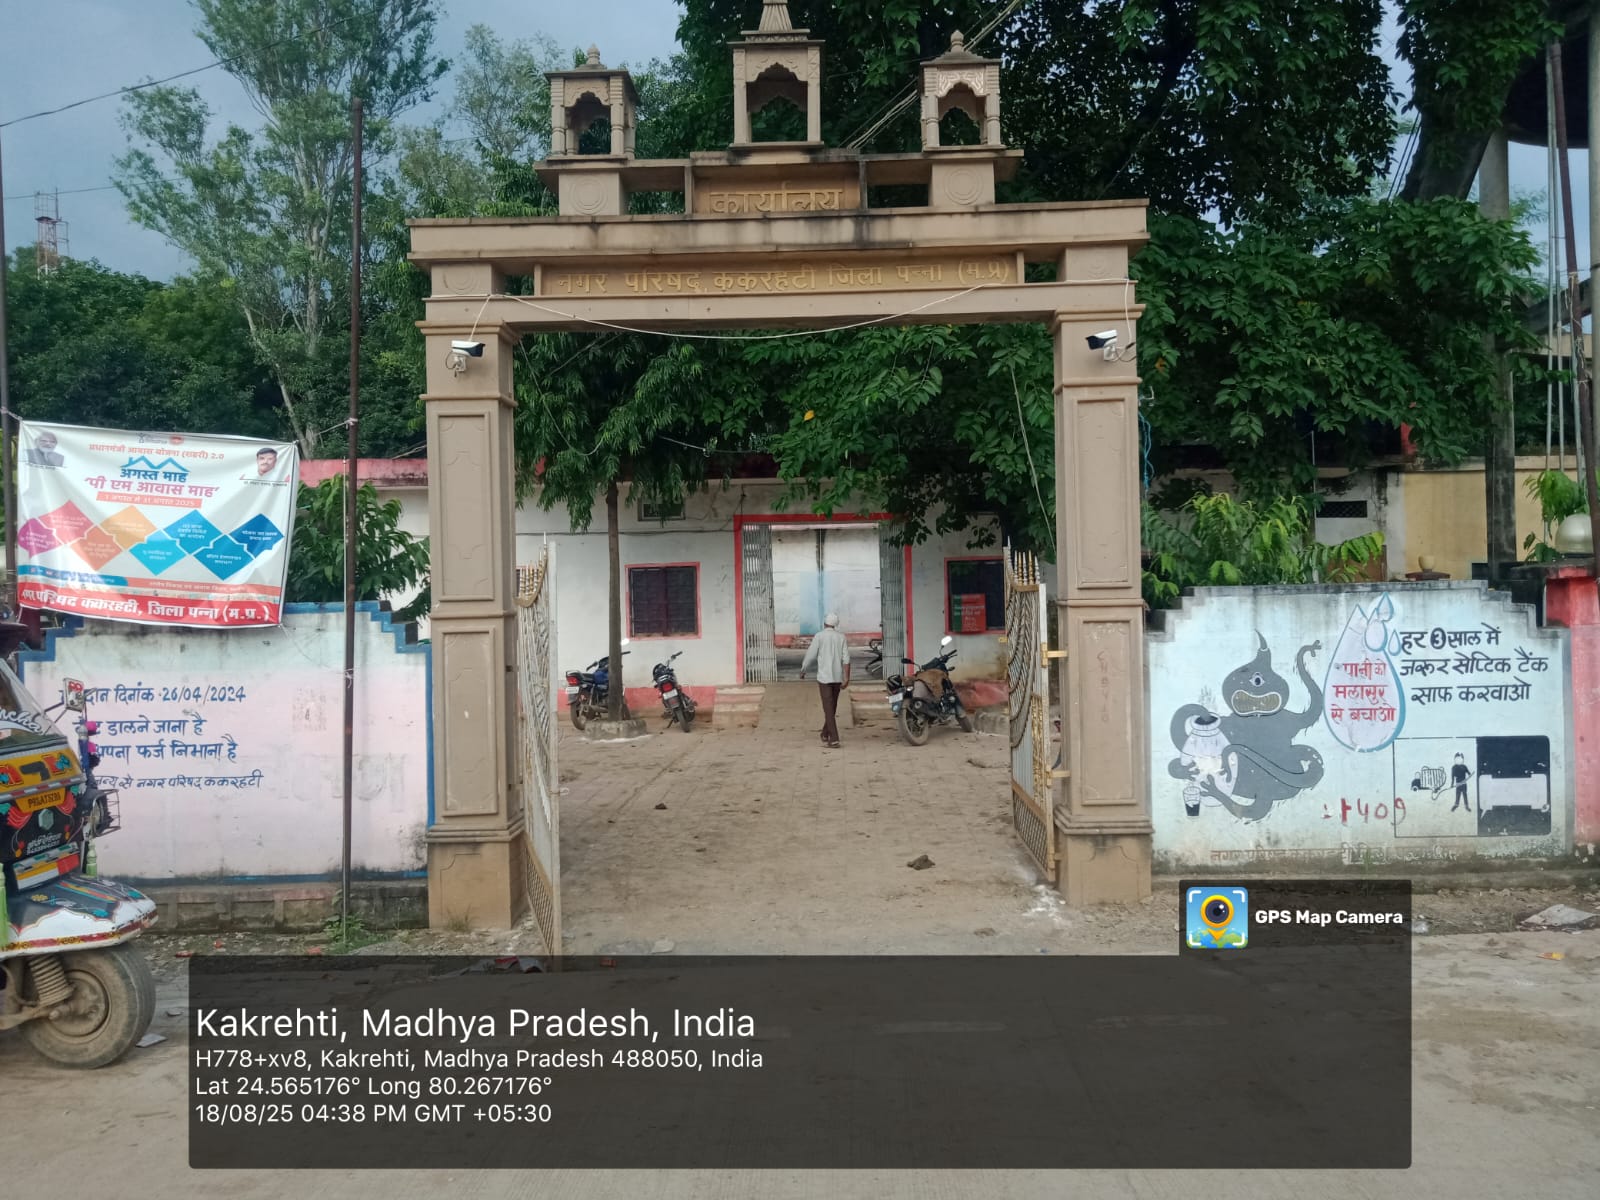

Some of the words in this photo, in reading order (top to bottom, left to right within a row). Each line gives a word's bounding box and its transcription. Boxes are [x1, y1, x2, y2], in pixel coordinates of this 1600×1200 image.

[708, 181, 844, 212] कार्यालय
[559, 273, 608, 293] नगर
[712, 263, 816, 293] ककरहटी
[826, 263, 882, 286] जिला
[896, 264, 942, 283] पन्ना
[120, 468, 159, 480] अगस्त
[162, 471, 189, 483] माह
[111, 480, 133, 492] एम
[137, 482, 184, 495] आवास
[147, 600, 185, 617] जिला
[188, 606, 220, 619] पन्ना
[1400, 630, 1428, 655] हर
[1447, 630, 1482, 649] साल
[1481, 622, 1502, 646] में
[1342, 658, 1373, 680] पानी
[1399, 658, 1451, 677] जरूर
[1453, 651, 1511, 675] सेप्टिक
[1513, 646, 1549, 673] टैंक
[114, 682, 155, 705] दिनांक
[1332, 685, 1389, 705] मलासुर
[1457, 676, 1532, 702] करवाओ
[106, 715, 150, 736] डालने
[153, 719, 189, 735] जाना
[191, 712, 207, 736] है
[1331, 703, 1344, 724] से
[1348, 703, 1396, 722] बचाओ
[136, 738, 166, 760] फर्ज
[170, 740, 223, 761] निभाना
[221, 733, 238, 764] है
[119, 773, 134, 790] से
[137, 778, 167, 789] नगर
[168, 774, 203, 790] परिषद
[204, 769, 265, 789] ककरहटी
